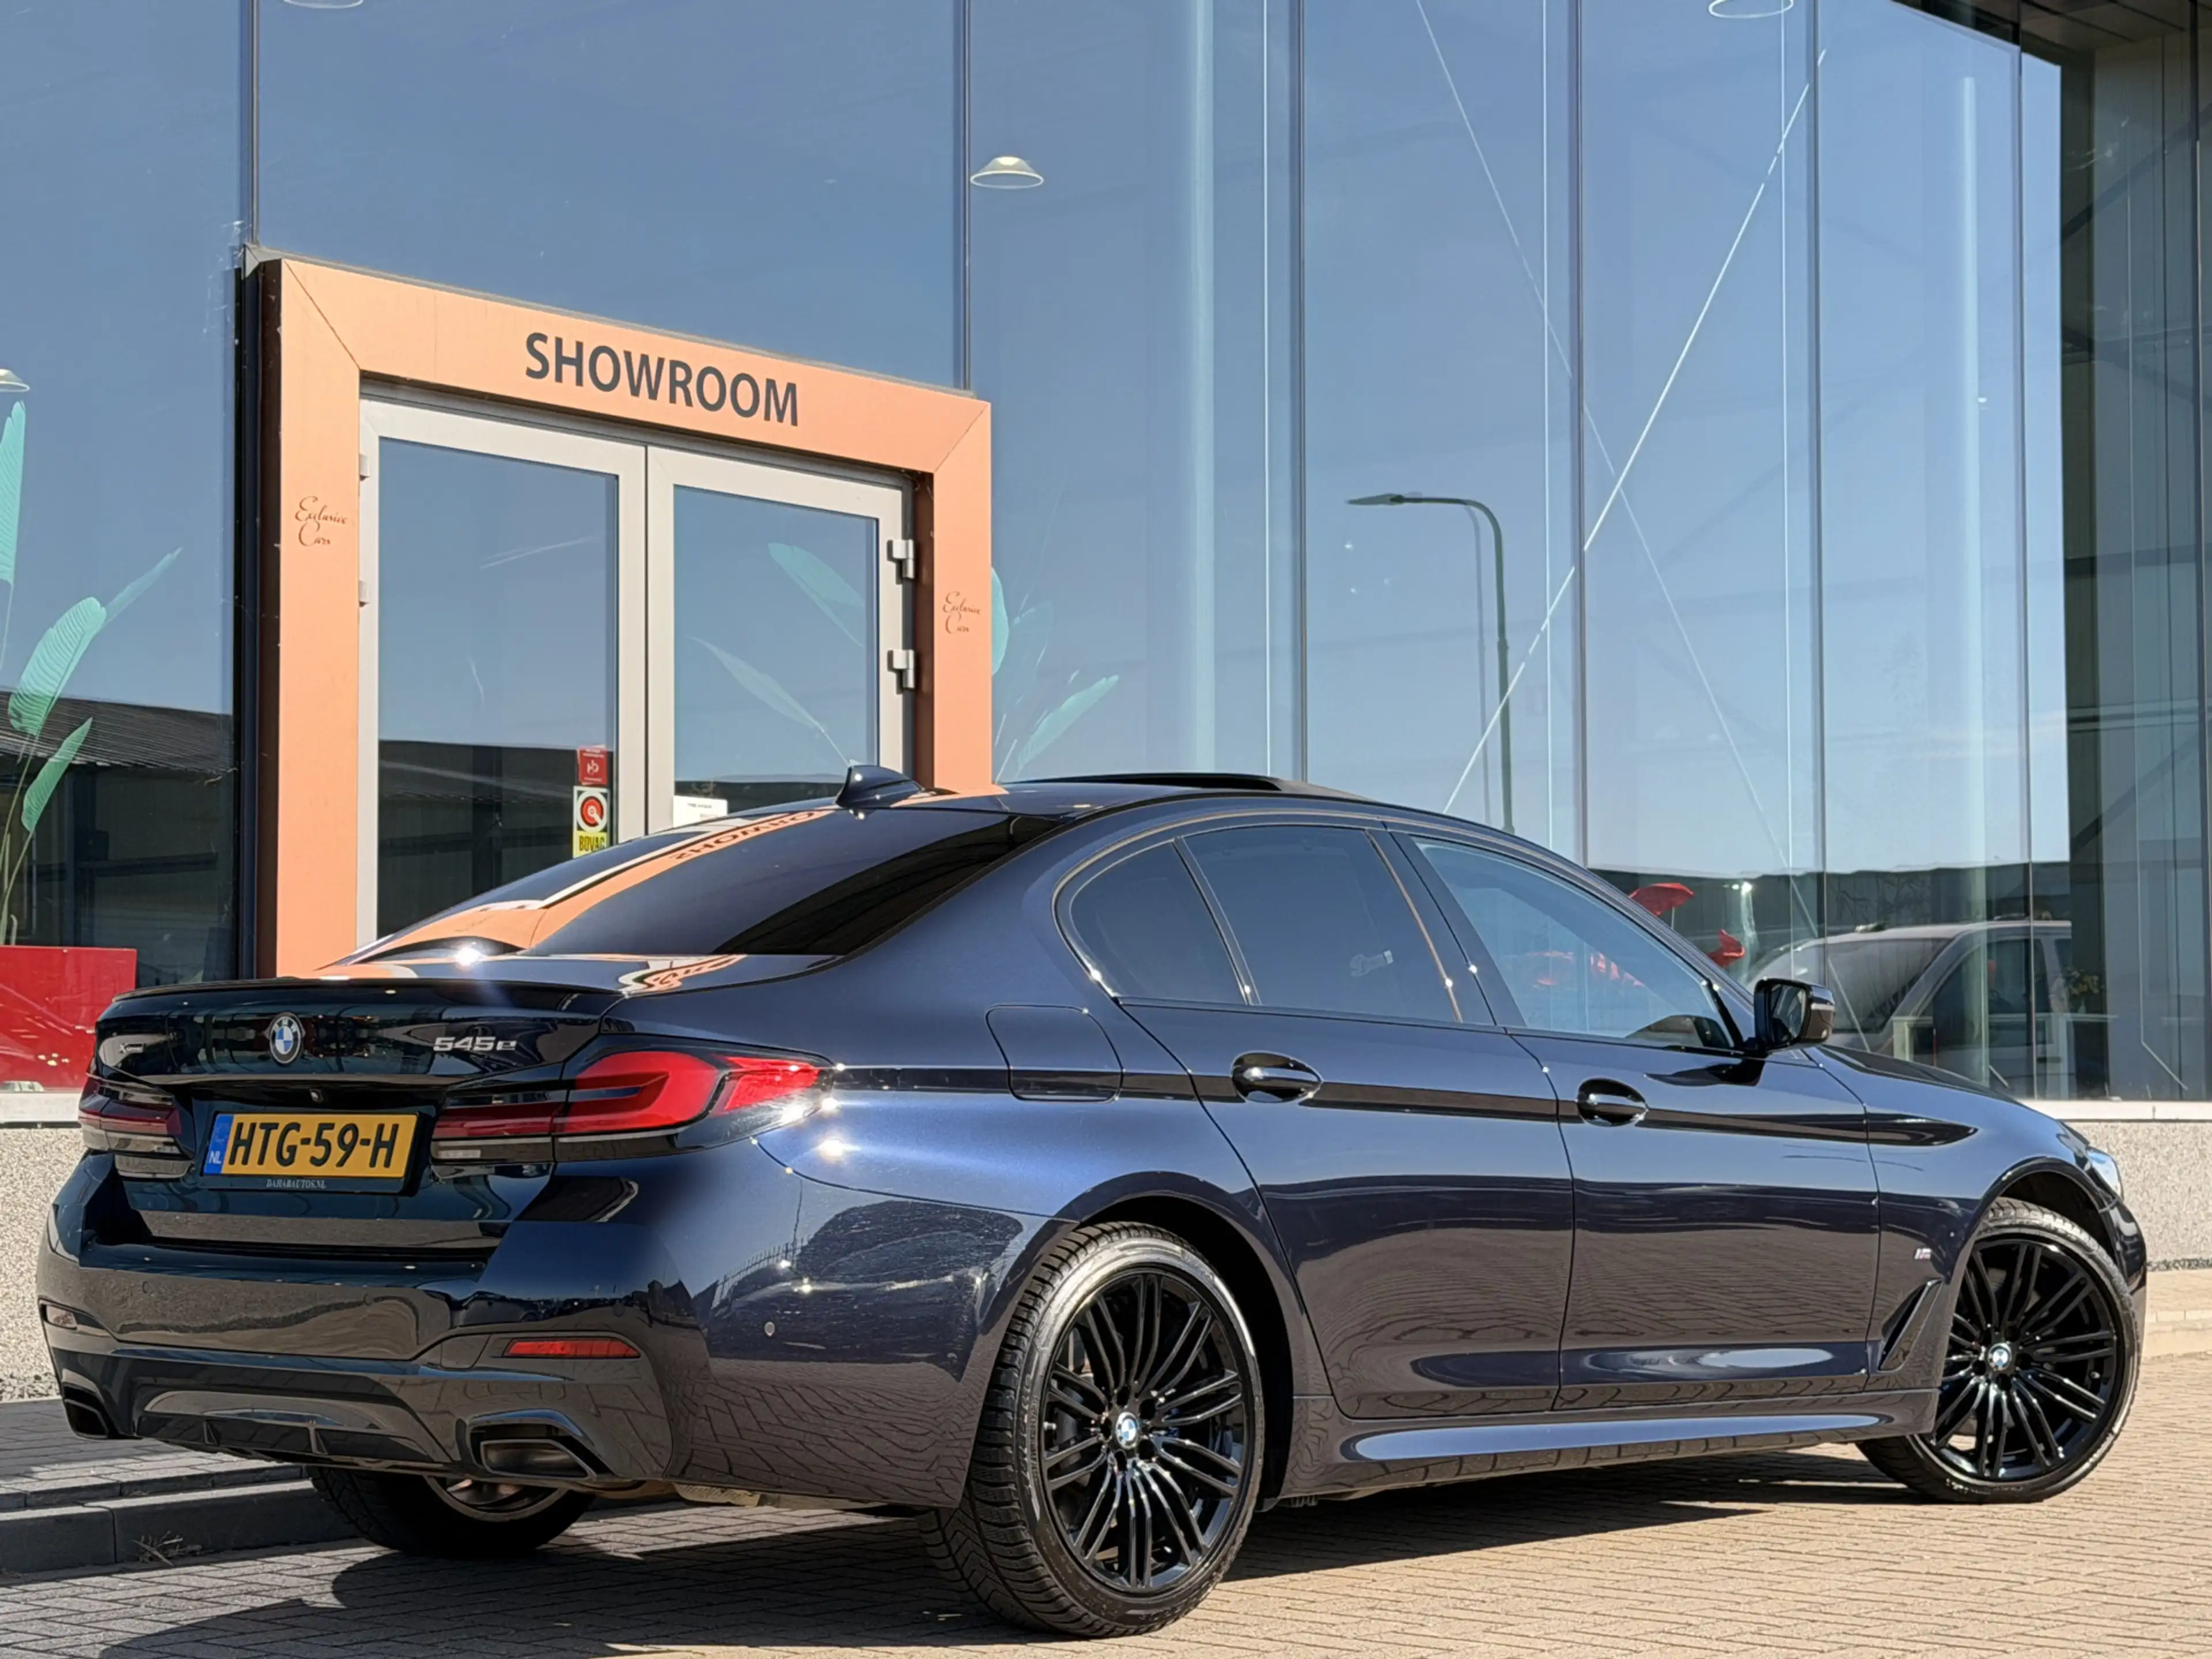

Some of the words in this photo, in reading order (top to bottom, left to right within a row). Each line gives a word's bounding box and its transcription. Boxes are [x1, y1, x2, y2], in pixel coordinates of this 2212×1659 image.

[525, 332, 798, 427] SHOWROOM
[433, 1036, 517, 1052] 545e
[208, 1151, 222, 1164] NL
[228, 1122, 400, 1168] HTG-59-H
